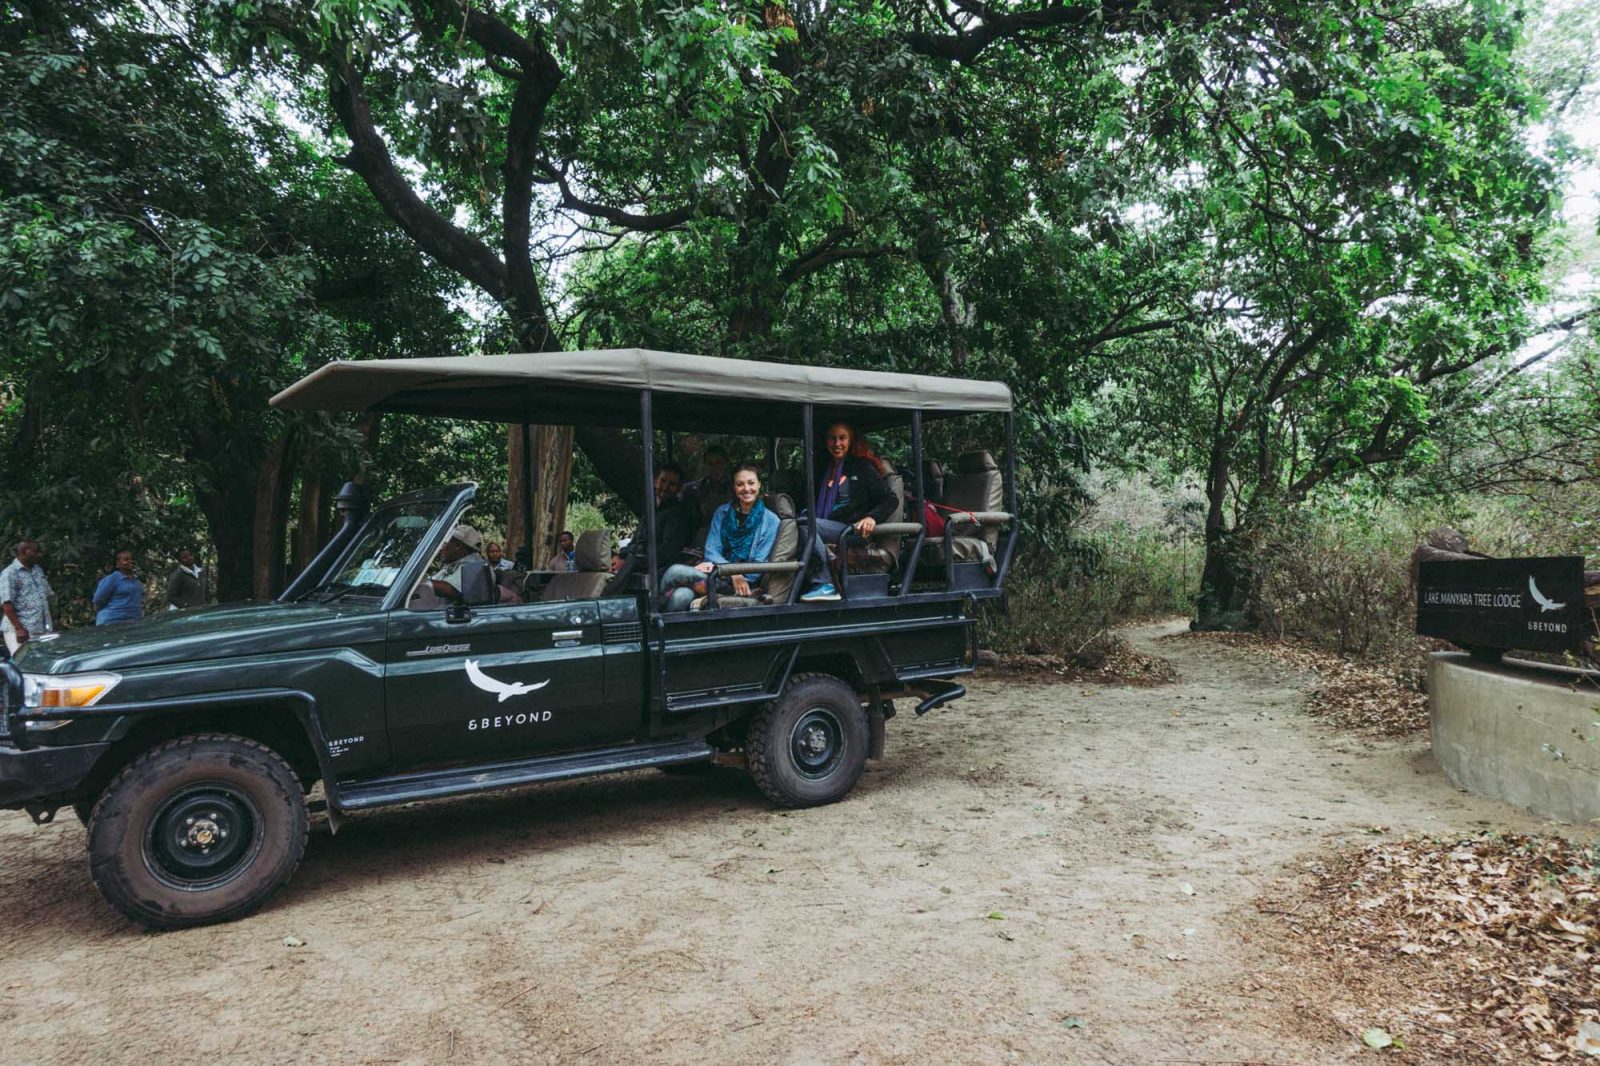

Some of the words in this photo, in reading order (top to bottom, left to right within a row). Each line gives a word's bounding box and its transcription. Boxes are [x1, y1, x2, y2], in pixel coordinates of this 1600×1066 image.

[1424, 592, 1440, 604] LAKE
[1440, 592, 1473, 606] MANYARA
[1473, 593, 1492, 607] TREE
[1493, 594, 1521, 608] LODGE
[1527, 621, 1568, 633] &BEYOND
[468, 711, 552, 731] &BEYOND
[328, 735, 364, 747] &BEYOND
